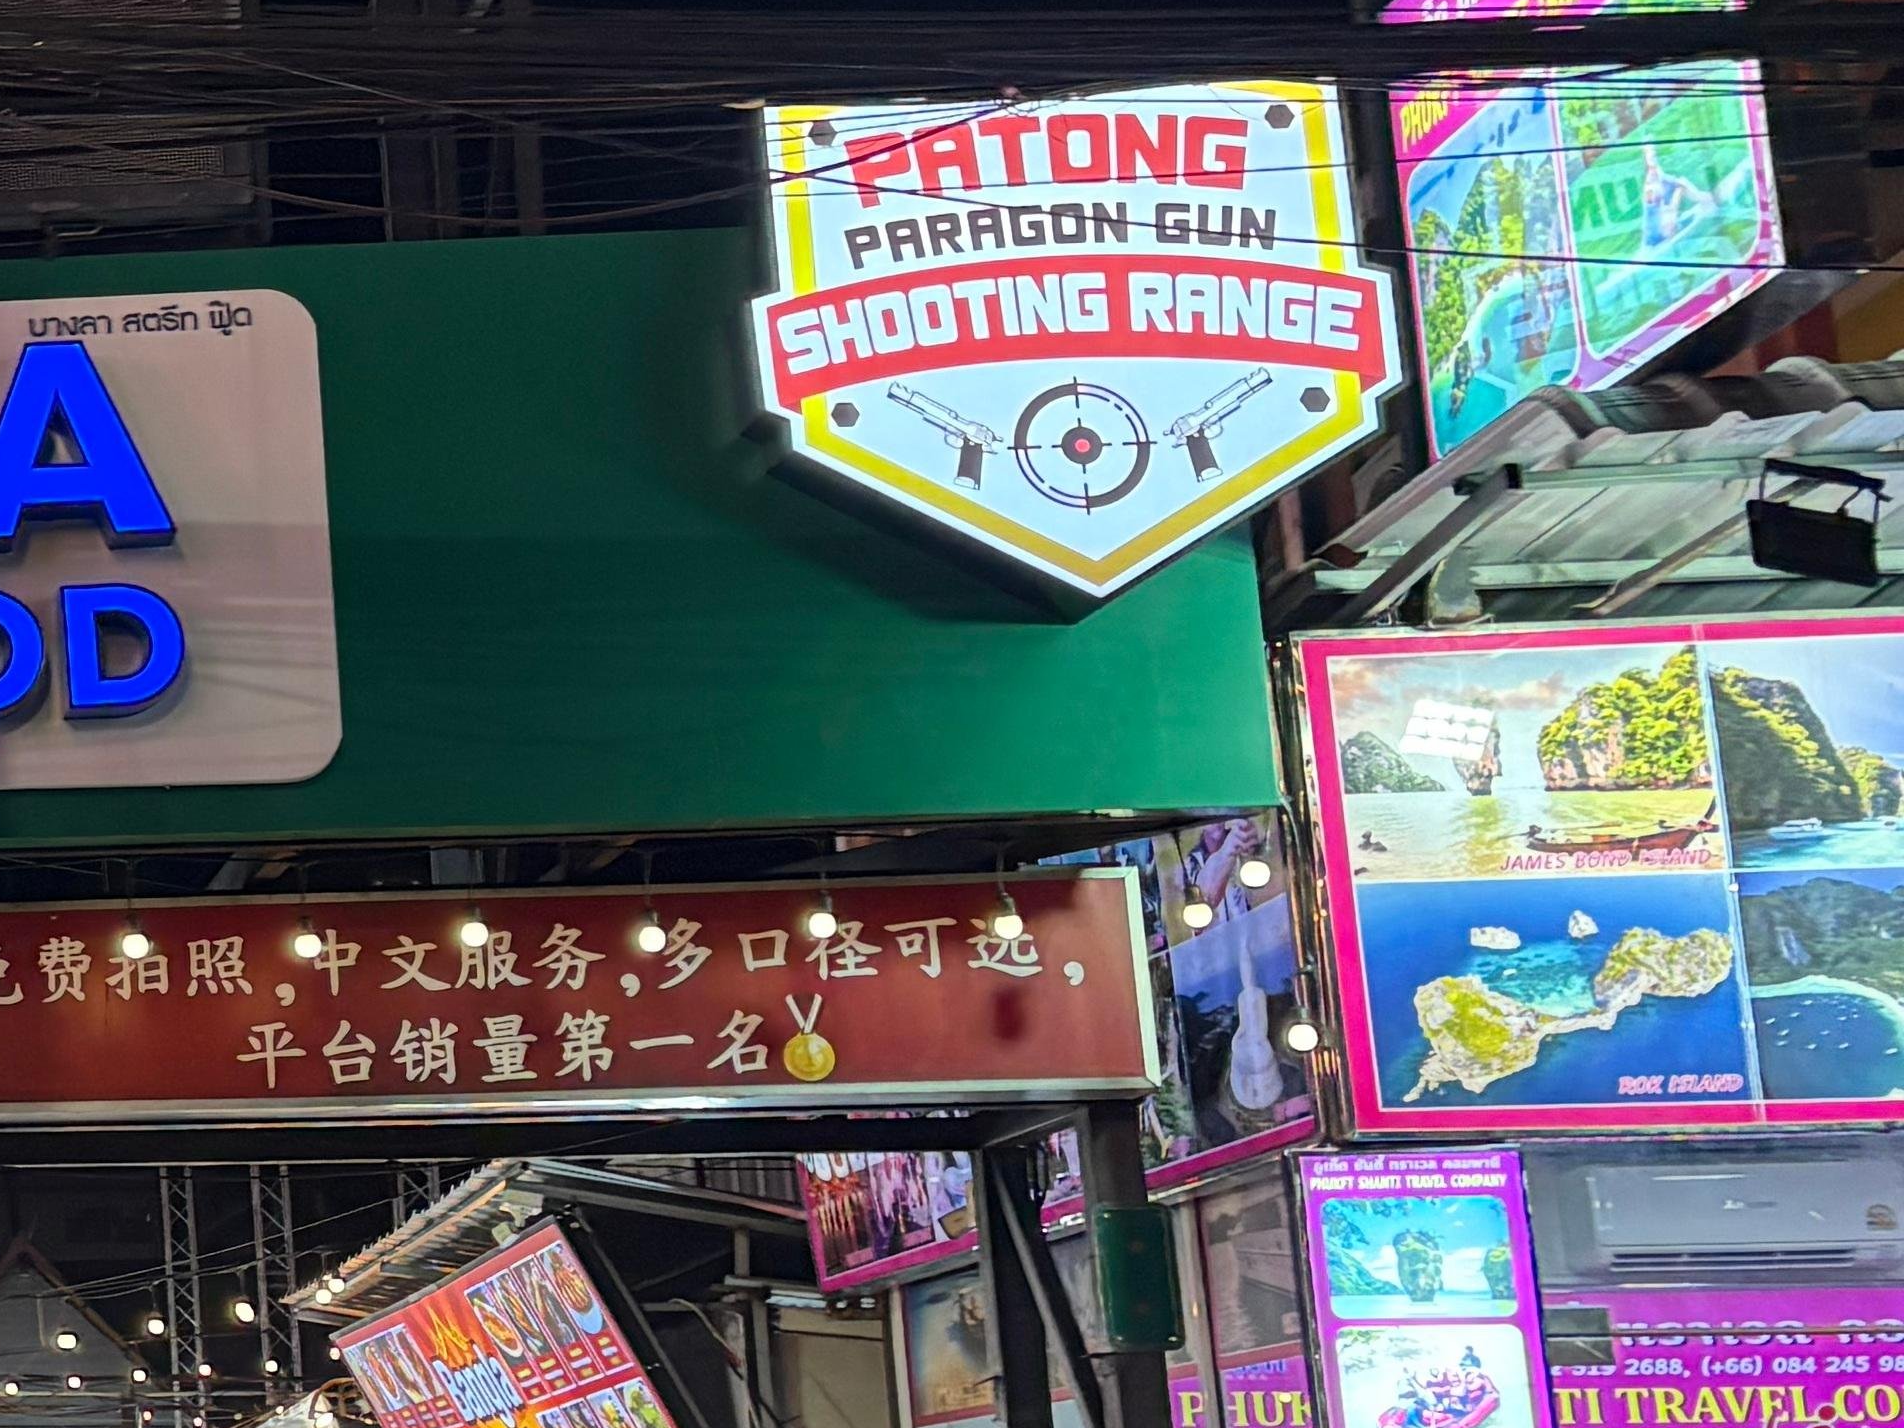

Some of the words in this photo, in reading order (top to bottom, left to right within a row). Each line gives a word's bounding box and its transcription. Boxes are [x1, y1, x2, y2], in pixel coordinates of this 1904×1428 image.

[844, 113, 1249, 205] PATONG
[844, 202, 1127, 268] PARAGON
[1155, 204, 1279, 252] GUN
[28, 315, 113, 337] บางลา
[774, 270, 1109, 368] SHOOTING
[1129, 270, 1361, 354] RANGE
[1500, 853, 1568, 871] JAMES
[1575, 850, 1633, 868] BOND
[1638, 848, 1713, 866] ISLAND
[237, 1008, 770, 1090] 平台销量第一名
[1668, 1073, 1744, 1093] ISLAND
[1450, 1173, 1508, 1188] COMPANY
[1623, 1358, 1692, 1378] 2688,
[1700, 1355, 1764, 1377] (+66)
[1772, 1356, 1817, 1374] 084
[1824, 1355, 1871, 1374] 245
[1615, 1385, 1819, 1426] TRAVEL
